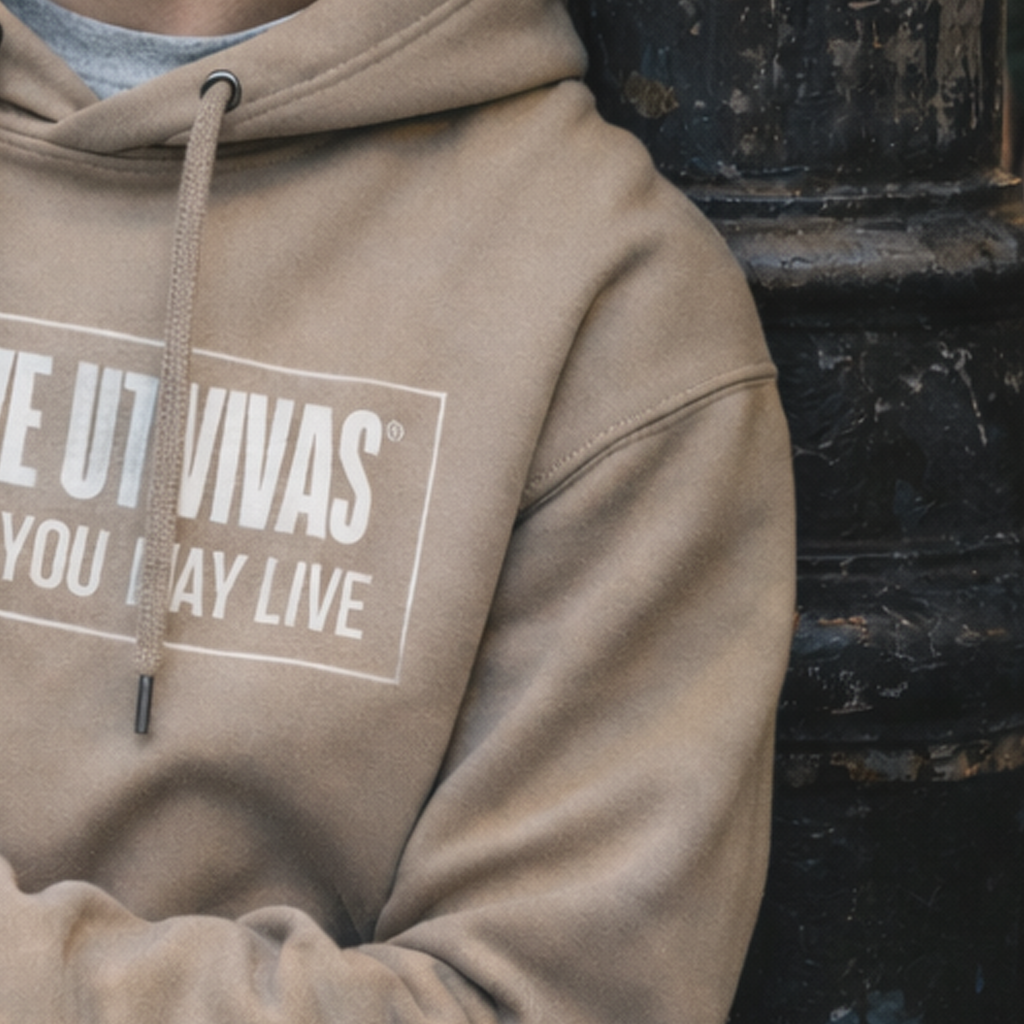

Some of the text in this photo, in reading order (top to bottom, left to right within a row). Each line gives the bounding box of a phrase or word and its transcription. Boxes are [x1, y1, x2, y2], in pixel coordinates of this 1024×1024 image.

[60, 361, 160, 509] UT
[2, 511, 110, 597] YOU
[254, 556, 373, 640] LIVE
